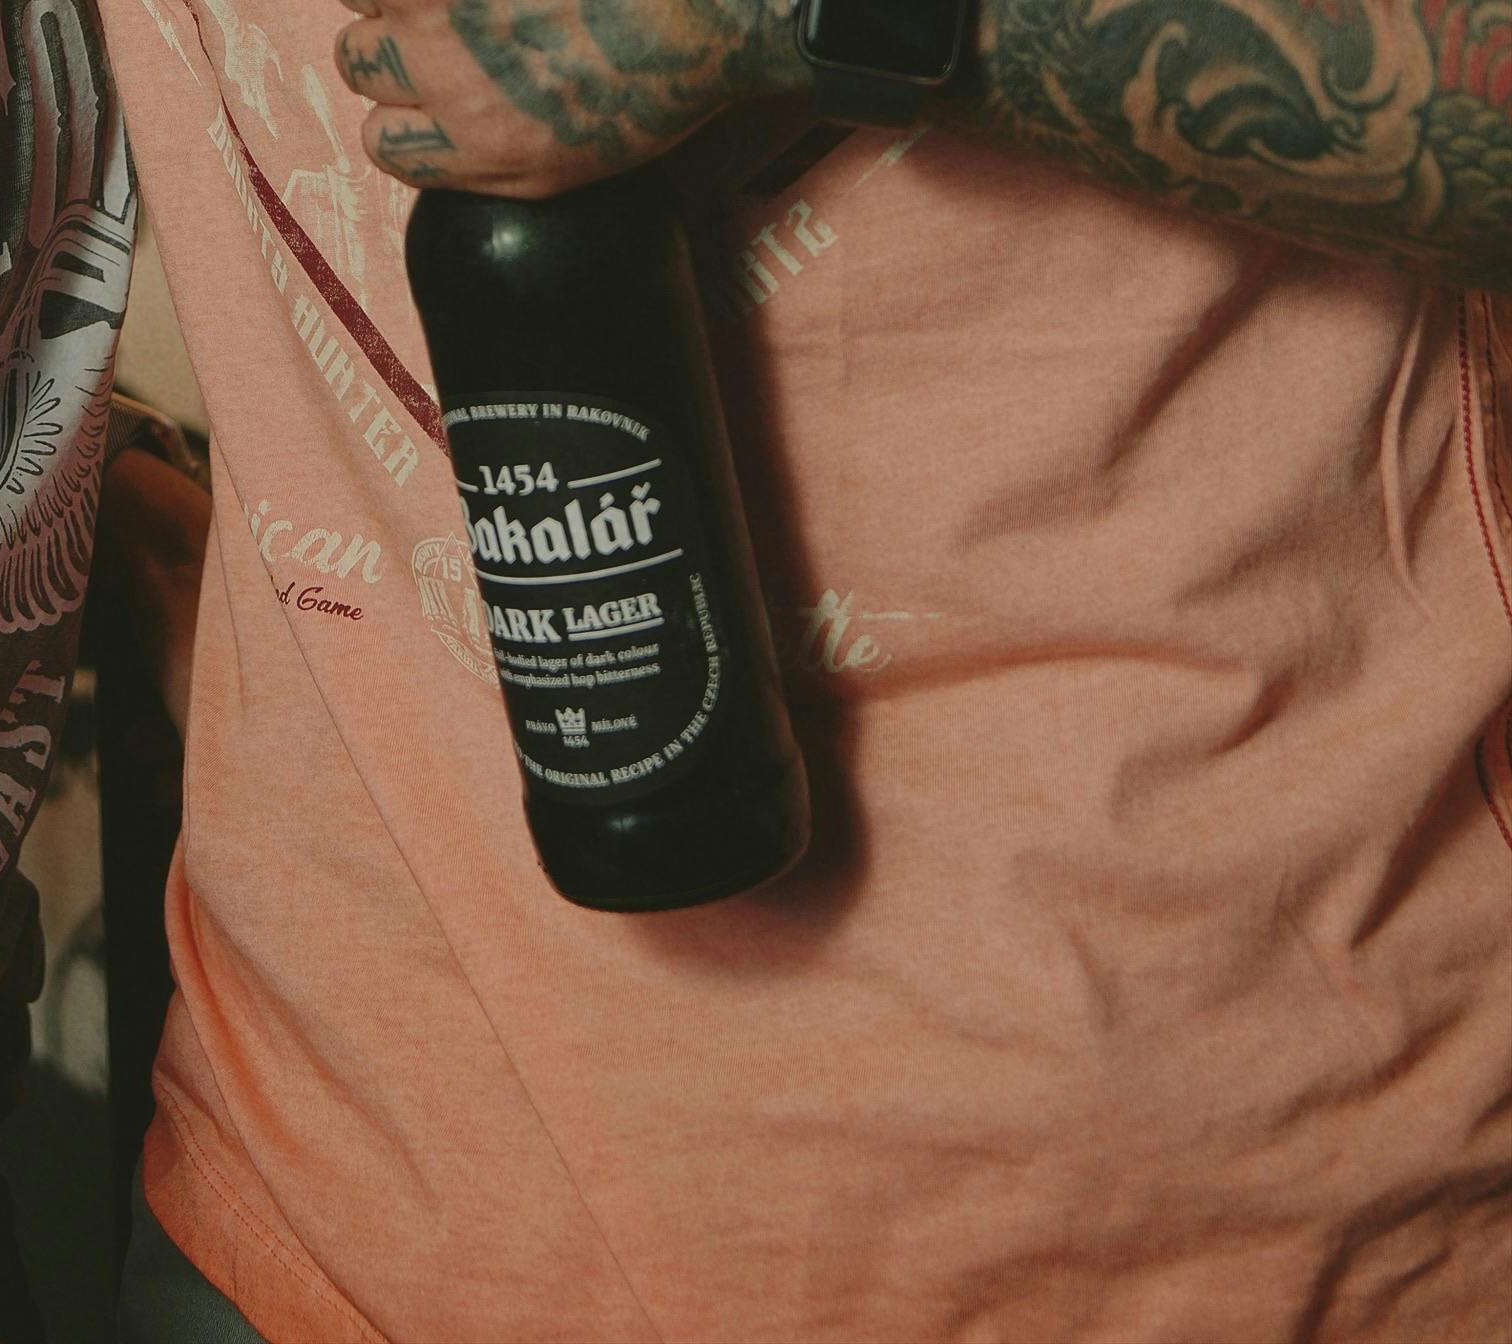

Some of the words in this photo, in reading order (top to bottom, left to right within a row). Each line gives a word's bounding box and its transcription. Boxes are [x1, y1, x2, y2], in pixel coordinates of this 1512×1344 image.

[292, 294, 419, 488] HUNTER
[470, 403, 538, 421] BREWERY
[542, 403, 563, 419] IN
[479, 462, 559, 496] 1454
[243, 498, 384, 585] ican
[296, 587, 364, 621] Game
[562, 592, 663, 633] LAGER
[538, 648, 568, 673] lager
[569, 653, 584, 669] of
[585, 650, 616, 668] dark
[617, 643, 660, 661] colour
[571, 673, 596, 690] hop
[596, 663, 662, 685] bitterness
[545, 767, 611, 789] ORIGINAL
[610, 752, 667, 785] RECIPE
[664, 739, 685, 762] IN
[680, 711, 708, 745] THE
[702, 656, 722, 713] CZECH
[563, 735, 590, 749] 1454
